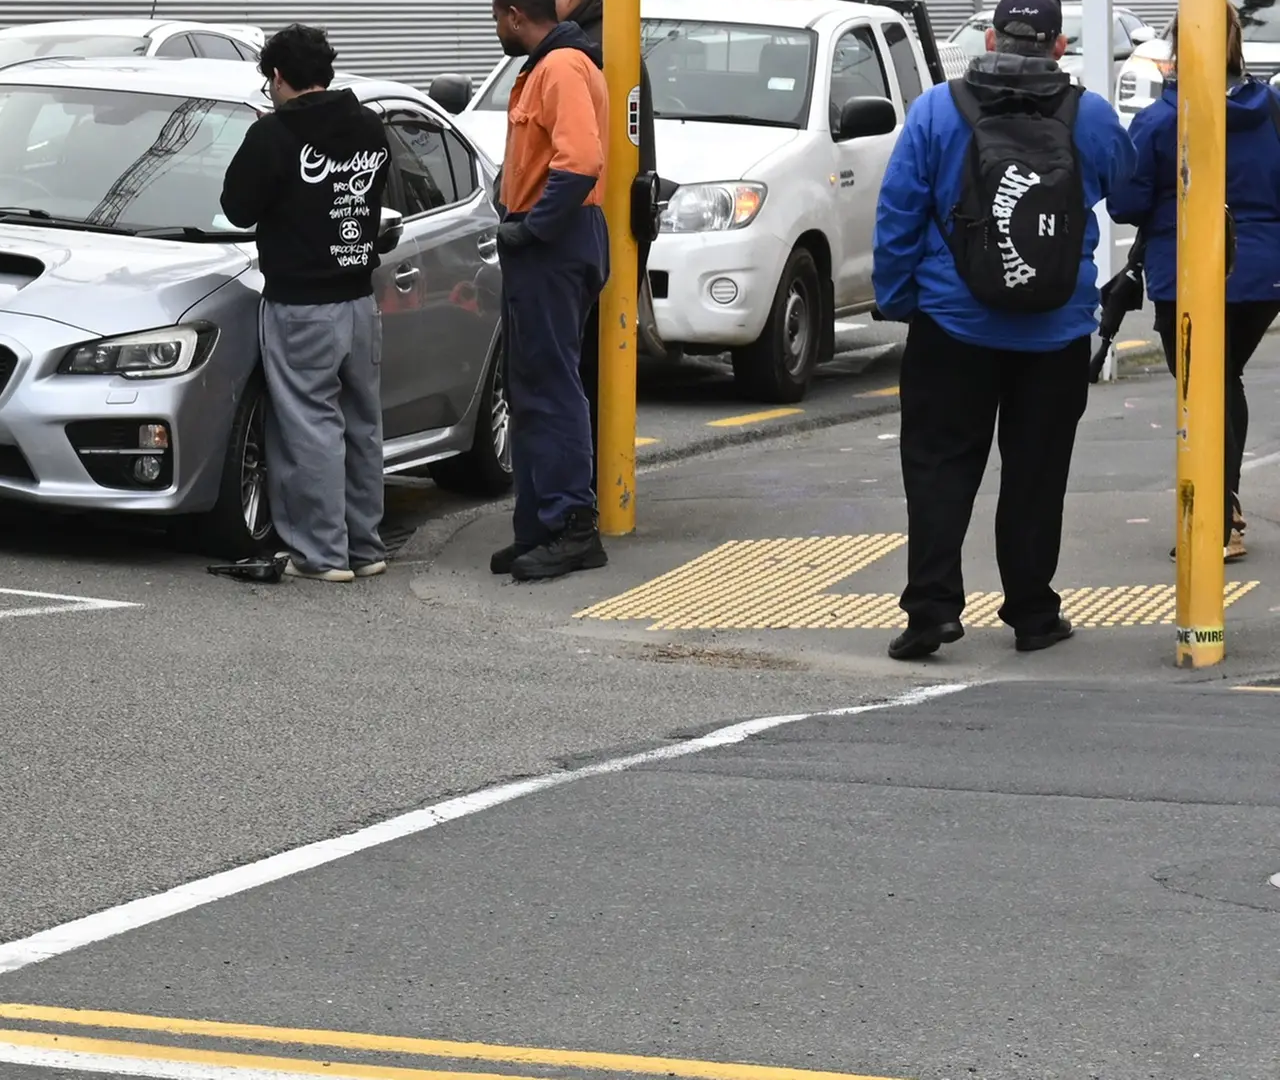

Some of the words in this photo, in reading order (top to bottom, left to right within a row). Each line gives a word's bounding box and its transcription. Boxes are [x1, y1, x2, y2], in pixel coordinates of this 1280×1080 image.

[333, 194, 366, 206] COMPTON
[329, 206, 351, 219] SANTA
[352, 206, 371, 217] ANA
[330, 241, 374, 256] BROOKLYN
